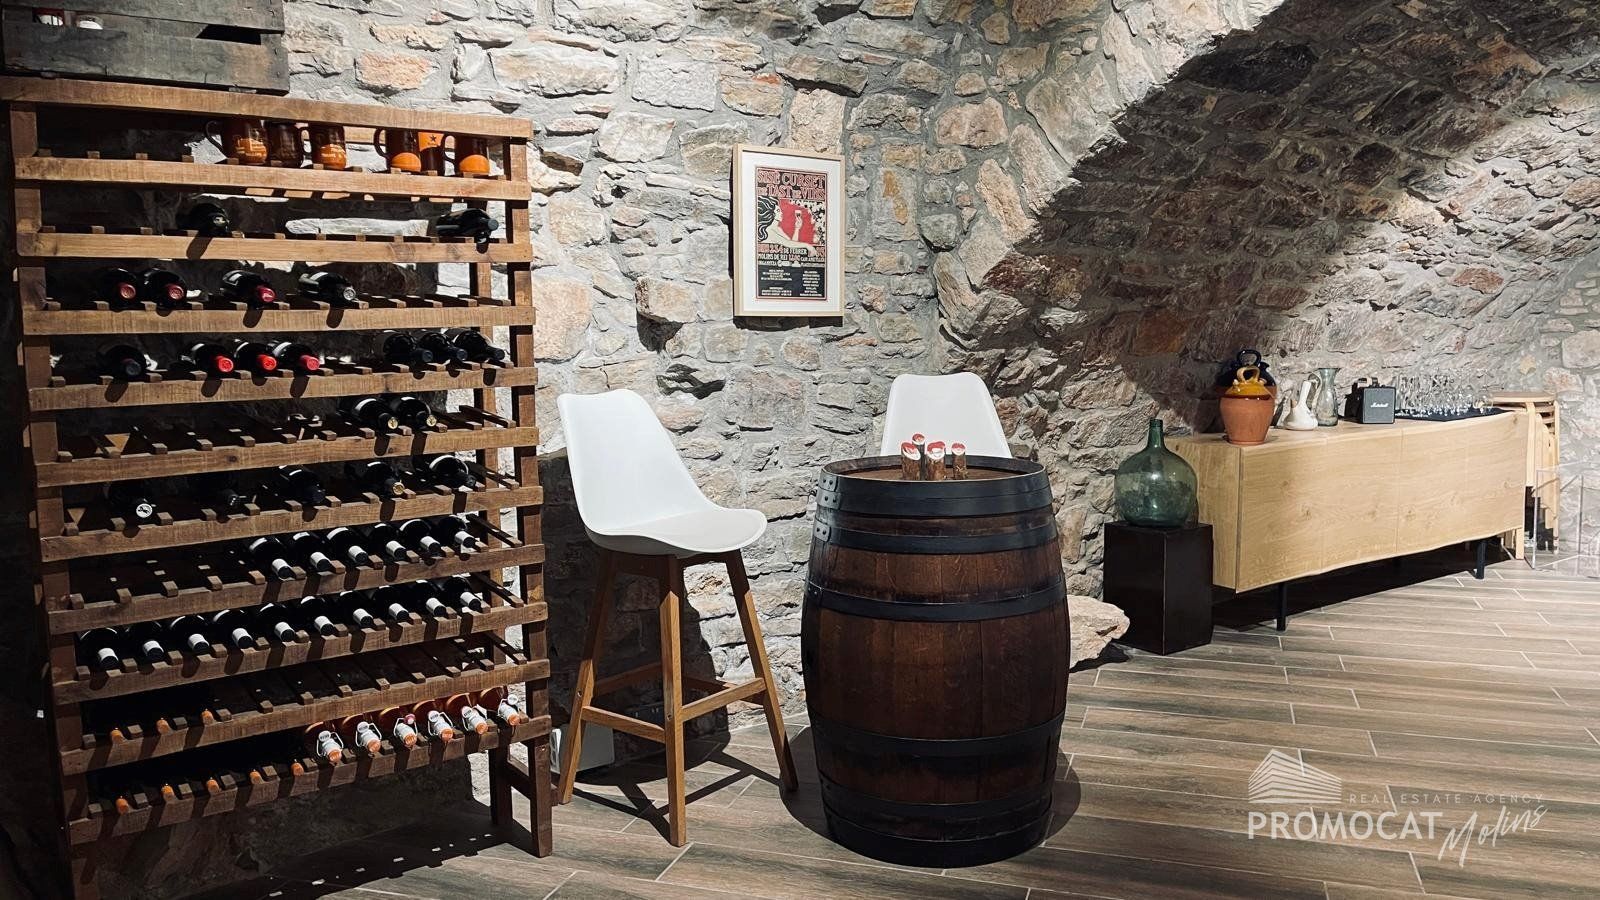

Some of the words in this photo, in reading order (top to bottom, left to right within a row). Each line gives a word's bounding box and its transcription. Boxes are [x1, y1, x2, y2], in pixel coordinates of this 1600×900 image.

[782, 173, 825, 189] CURSET
[767, 184, 792, 198] TAST
[801, 187, 825, 201] VINS
